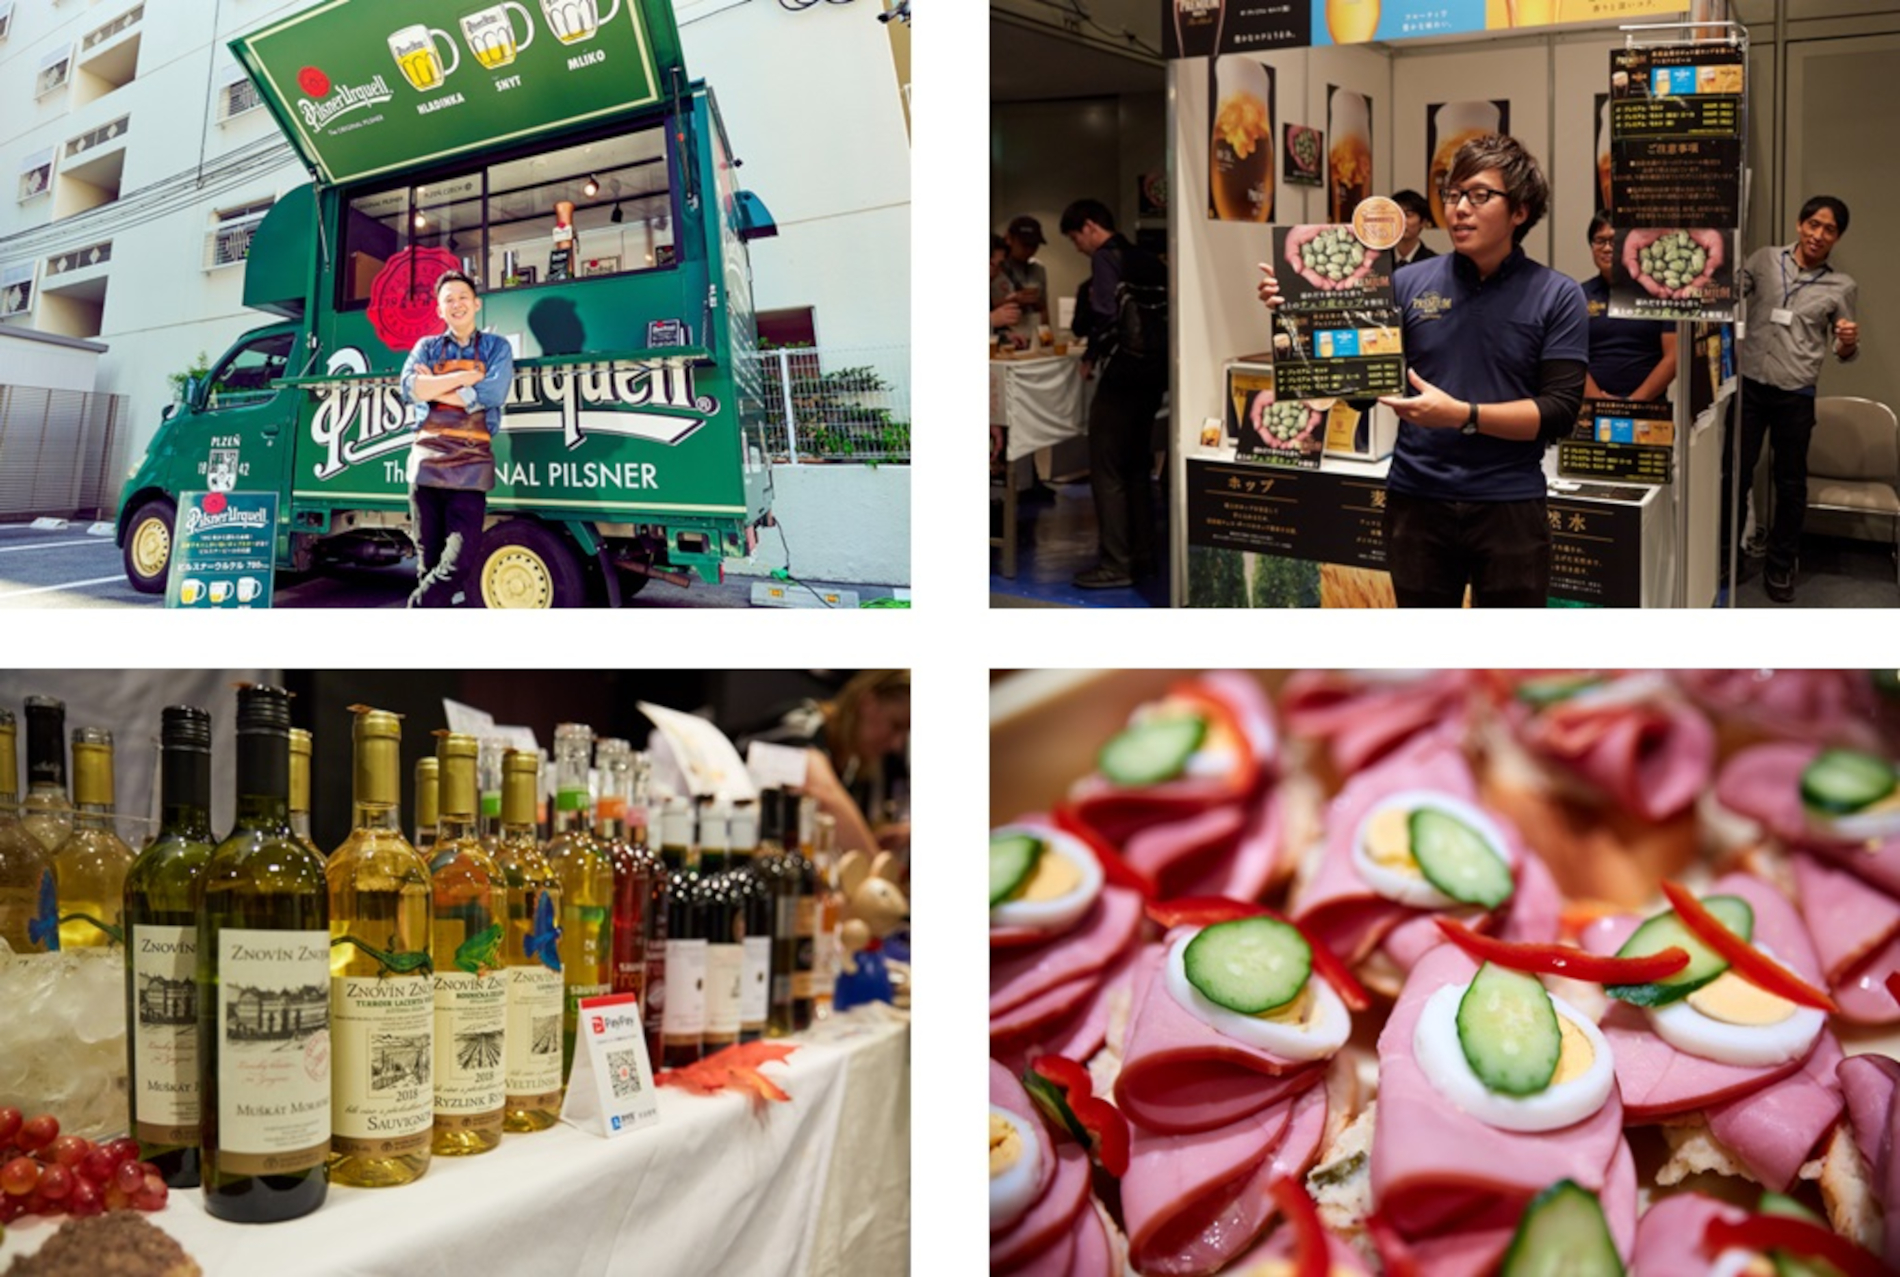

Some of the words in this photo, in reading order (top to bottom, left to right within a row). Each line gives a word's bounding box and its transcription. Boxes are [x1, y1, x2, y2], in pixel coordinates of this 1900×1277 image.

[416, 92, 466, 114] HLADINKA
[239, 462, 250, 476] 42
[383, 461, 414, 484] Th
[548, 462, 659, 488] PILSNER
[1228, 475, 1275, 493] ホップ
[1370, 489, 1387, 508] 麦
[1547, 511, 1586, 532] 然水
[231, 945, 292, 961] ZNOVÍN
[347, 983, 405, 998] ZNOVÍN
[434, 976, 483, 990] ZNOVÍN
[396, 1088, 419, 1102] 2018
[433, 1094, 487, 1108] RYZLINK
[236, 1102, 286, 1117] MUŠKÁT
